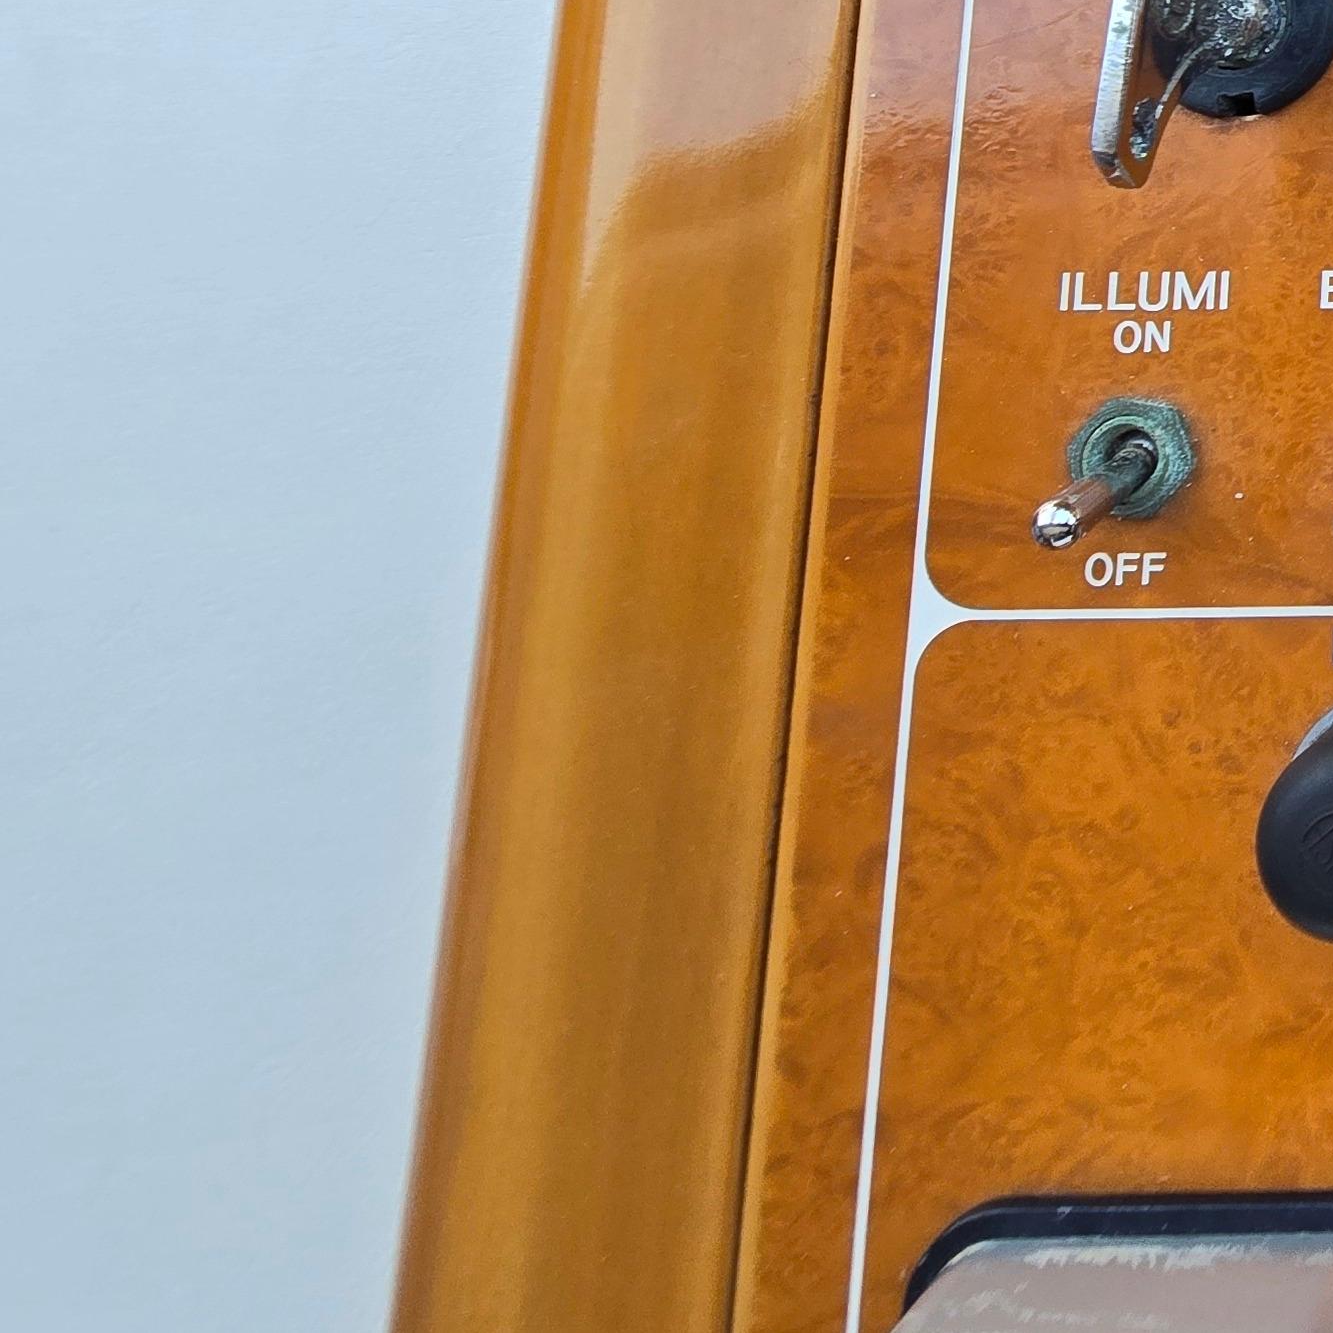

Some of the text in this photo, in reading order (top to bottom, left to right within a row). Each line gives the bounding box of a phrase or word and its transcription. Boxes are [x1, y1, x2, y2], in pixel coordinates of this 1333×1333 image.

[1058, 269, 1231, 313] ILLUMI
[1112, 319, 1172, 354] ON
[1083, 551, 1167, 588] OFF
